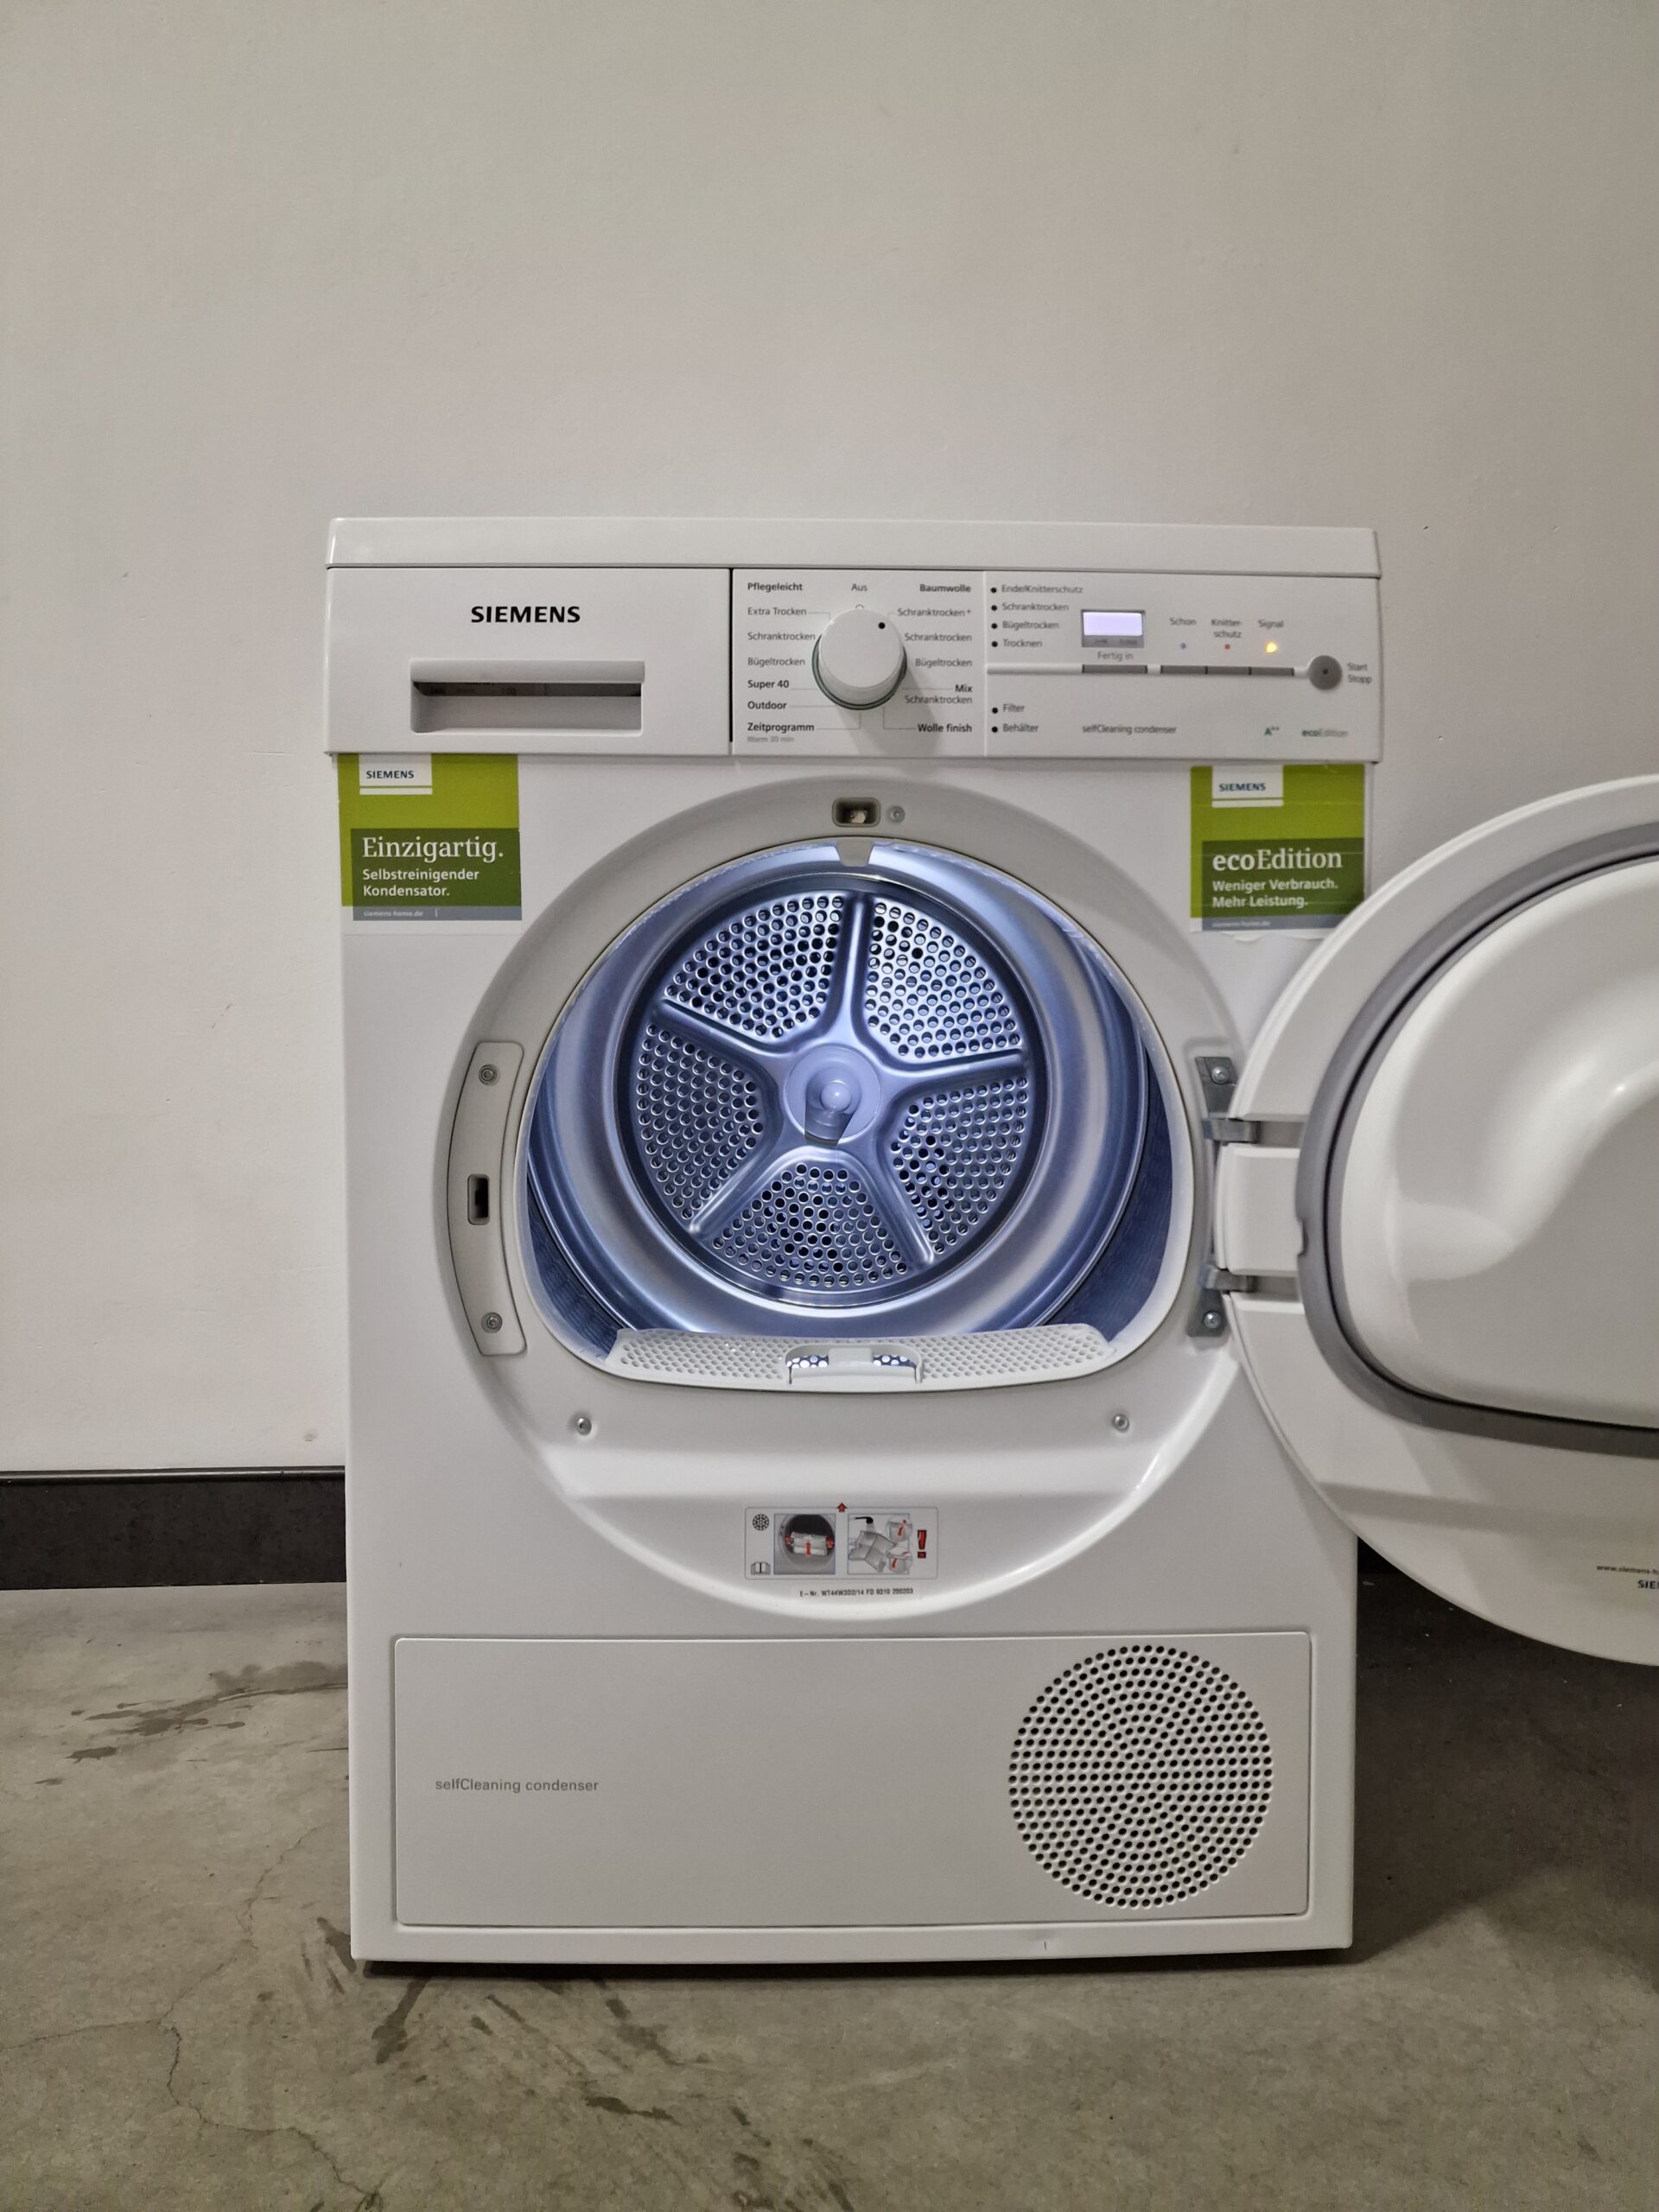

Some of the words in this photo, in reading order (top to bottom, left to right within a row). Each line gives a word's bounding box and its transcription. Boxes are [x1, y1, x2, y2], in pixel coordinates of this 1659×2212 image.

[747, 582, 803, 593] Pflegeleicht
[851, 583, 868, 592] Aus
[919, 583, 971, 594] Baumwolle
[747, 607, 771, 616] Extra
[772, 607, 807, 616] Trocken
[1001, 602, 1069, 611] Schranktrocken
[471, 606, 581, 623] SIEMENS
[1002, 620, 1059, 632] Bügeltrocken
[1169, 617, 1197, 626] Schon
[1211, 619, 1243, 627] Knitter-
[1258, 620, 1284, 630] Signal
[747, 631, 816, 641] Schranktrocken
[904, 632, 972, 643] Schranktrocken
[1213, 630, 1242, 639] schutz
[1003, 639, 1043, 648] Trocknen
[747, 656, 805, 667] Bügeltrocken
[1097, 651, 1123, 662] Fertig
[914, 657, 973, 669] Bügeltrocken
[747, 680, 774, 690] Super
[777, 680, 790, 689] 40
[955, 683, 973, 693] Mix
[747, 700, 787, 710] Outdoor
[905, 695, 973, 705] Schranktrocken
[1002, 704, 1025, 713] Filter
[747, 721, 815, 734] Zeitprogramm
[918, 722, 944, 733] Wolle
[946, 722, 972, 733] finish
[1002, 723, 1039, 733] Behälter
[1082, 724, 1132, 734] selfCleaning
[365, 770, 415, 779] SIEMENS
[1219, 783, 1266, 792] SIEMENS
[362, 836, 504, 863] Einzigartig.
[1212, 848, 1342, 871] ecoEdition
[362, 868, 480, 883] Selbstreinigender
[363, 885, 450, 897] Kondensator.
[1212, 880, 1267, 894] Weniger
[1269, 878, 1338, 891] Verbrauch.
[1212, 896, 1246, 908] Mehr
[1249, 894, 1309, 908] Leistung.
[435, 1778, 521, 1793] selfCleaning
[525, 1780, 600, 1791] condenser
